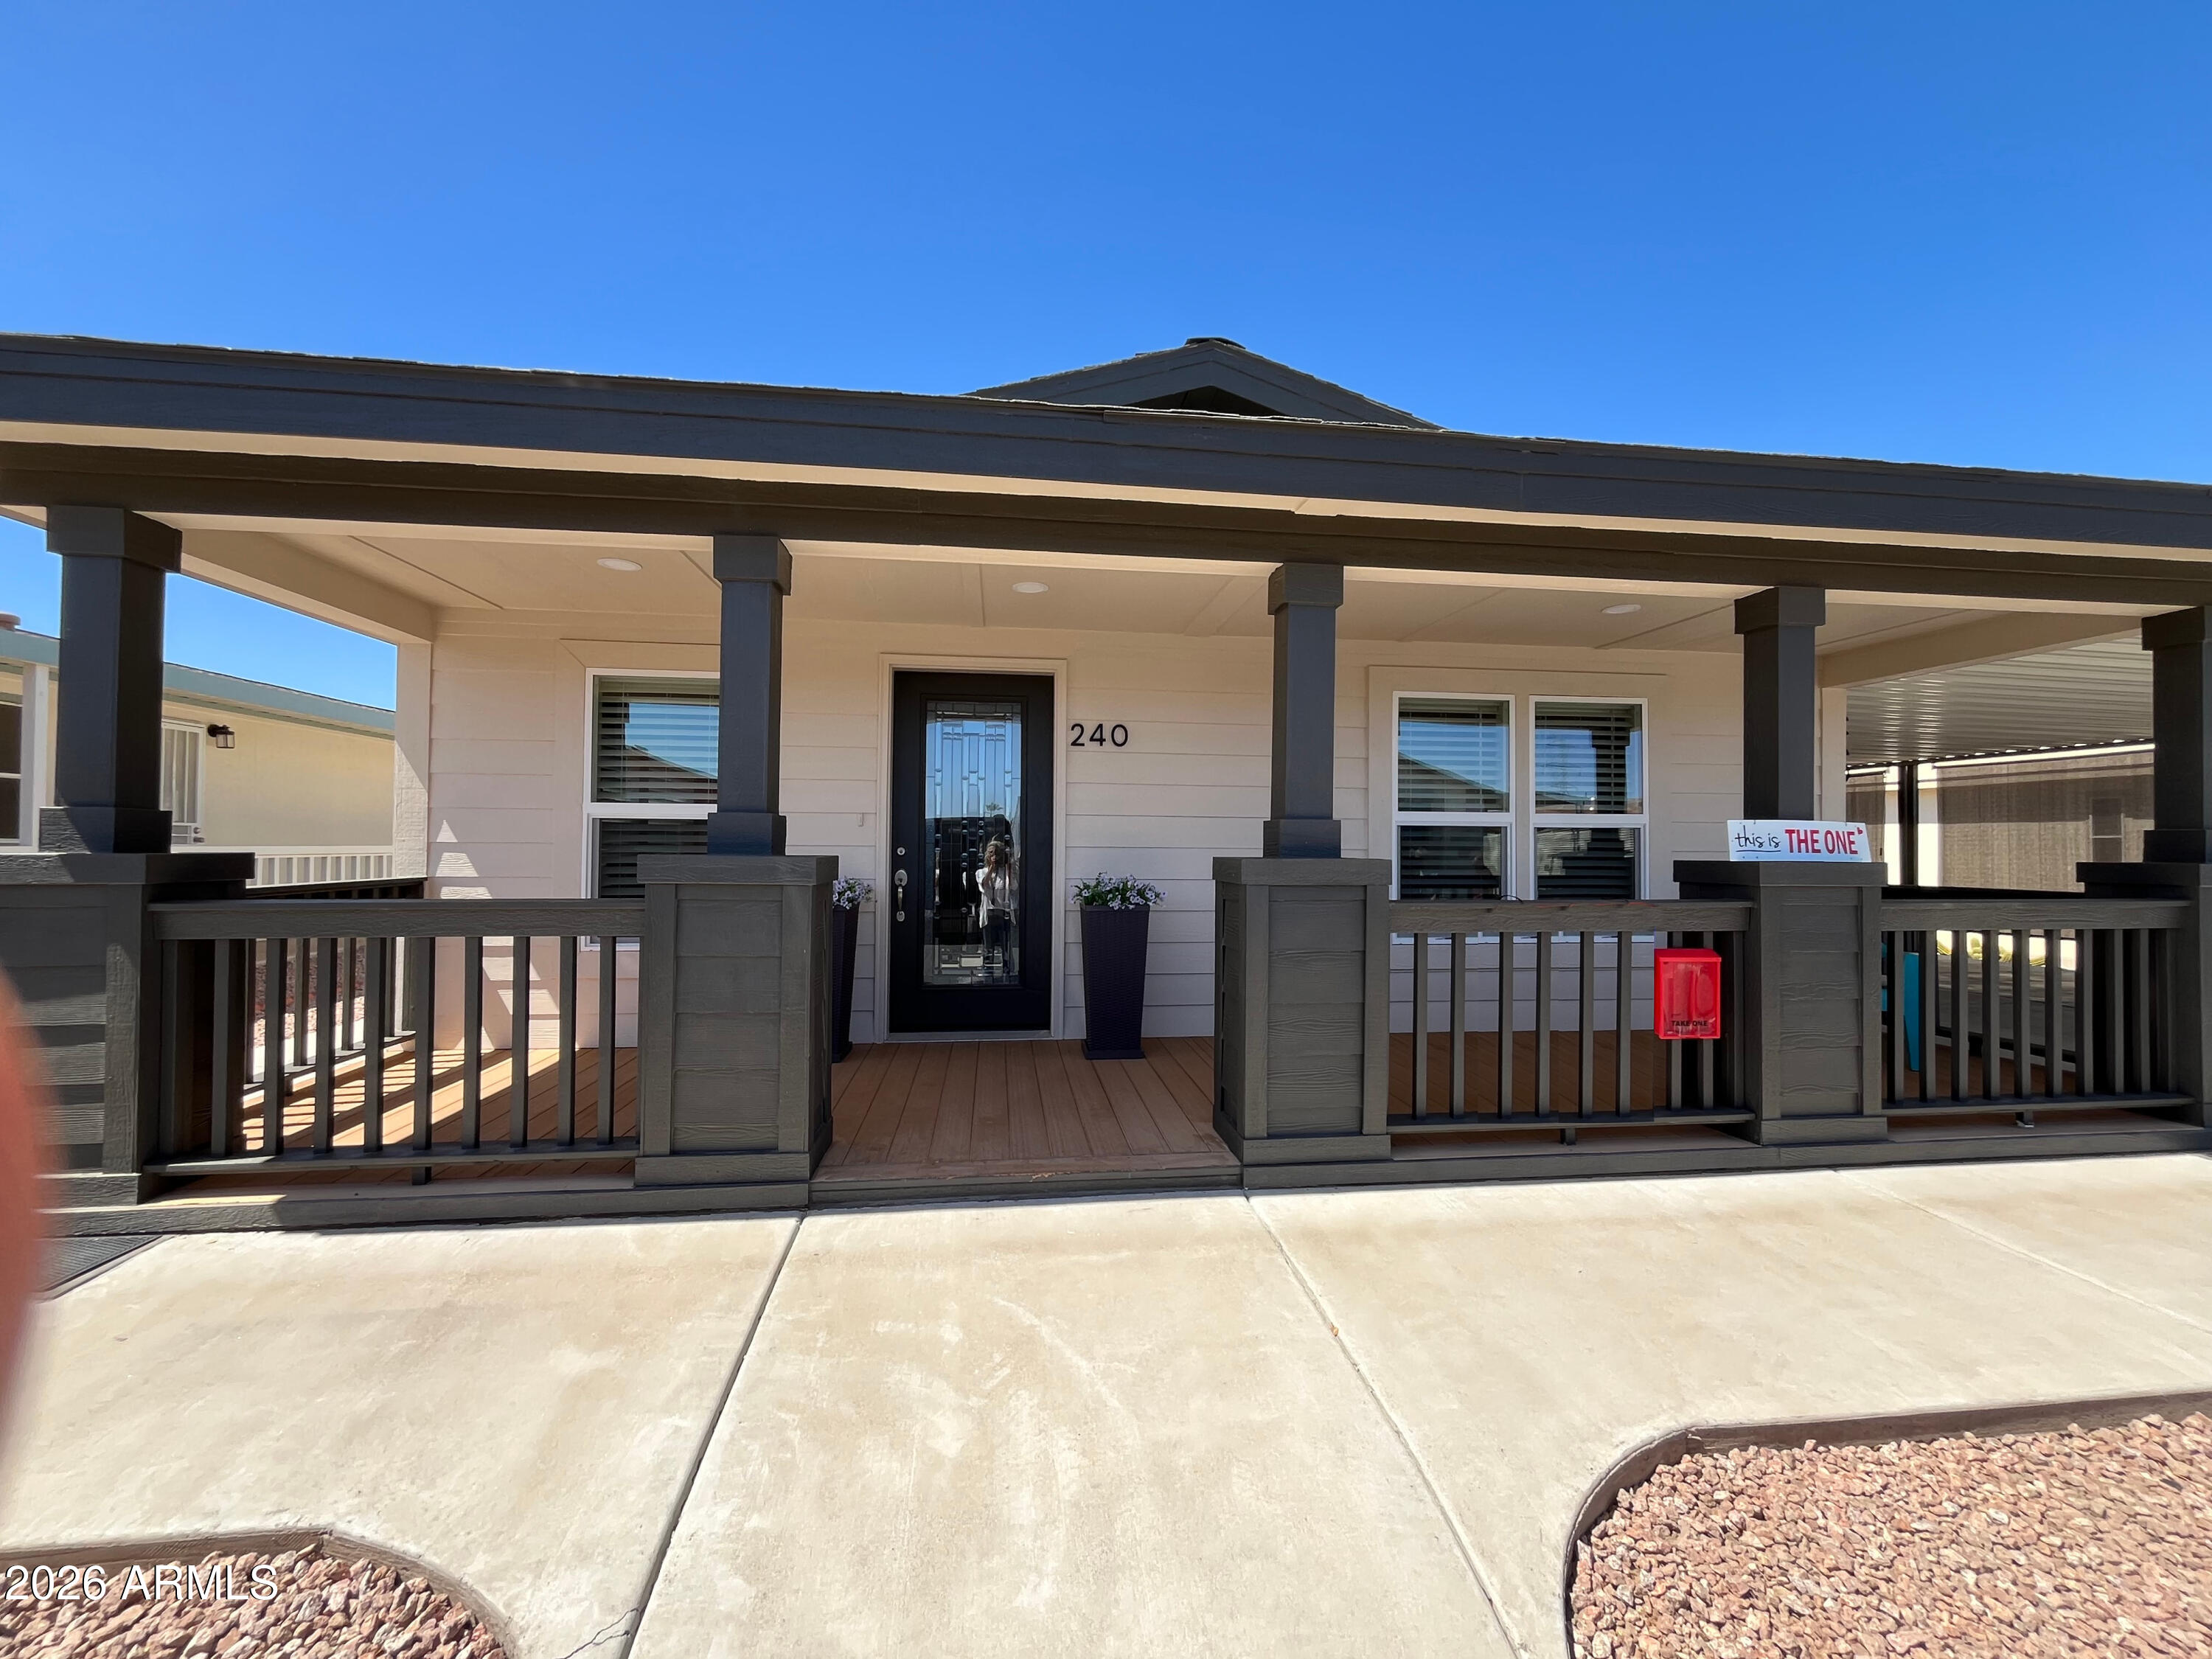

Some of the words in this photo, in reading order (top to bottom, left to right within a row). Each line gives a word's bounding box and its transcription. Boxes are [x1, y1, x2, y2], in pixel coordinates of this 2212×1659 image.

[1070, 723, 1129, 748] 240
[1735, 824, 1764, 849] this
[1767, 832, 1781, 849] is
[1784, 829, 1822, 854] THE
[1823, 830, 1859, 855] ONE
